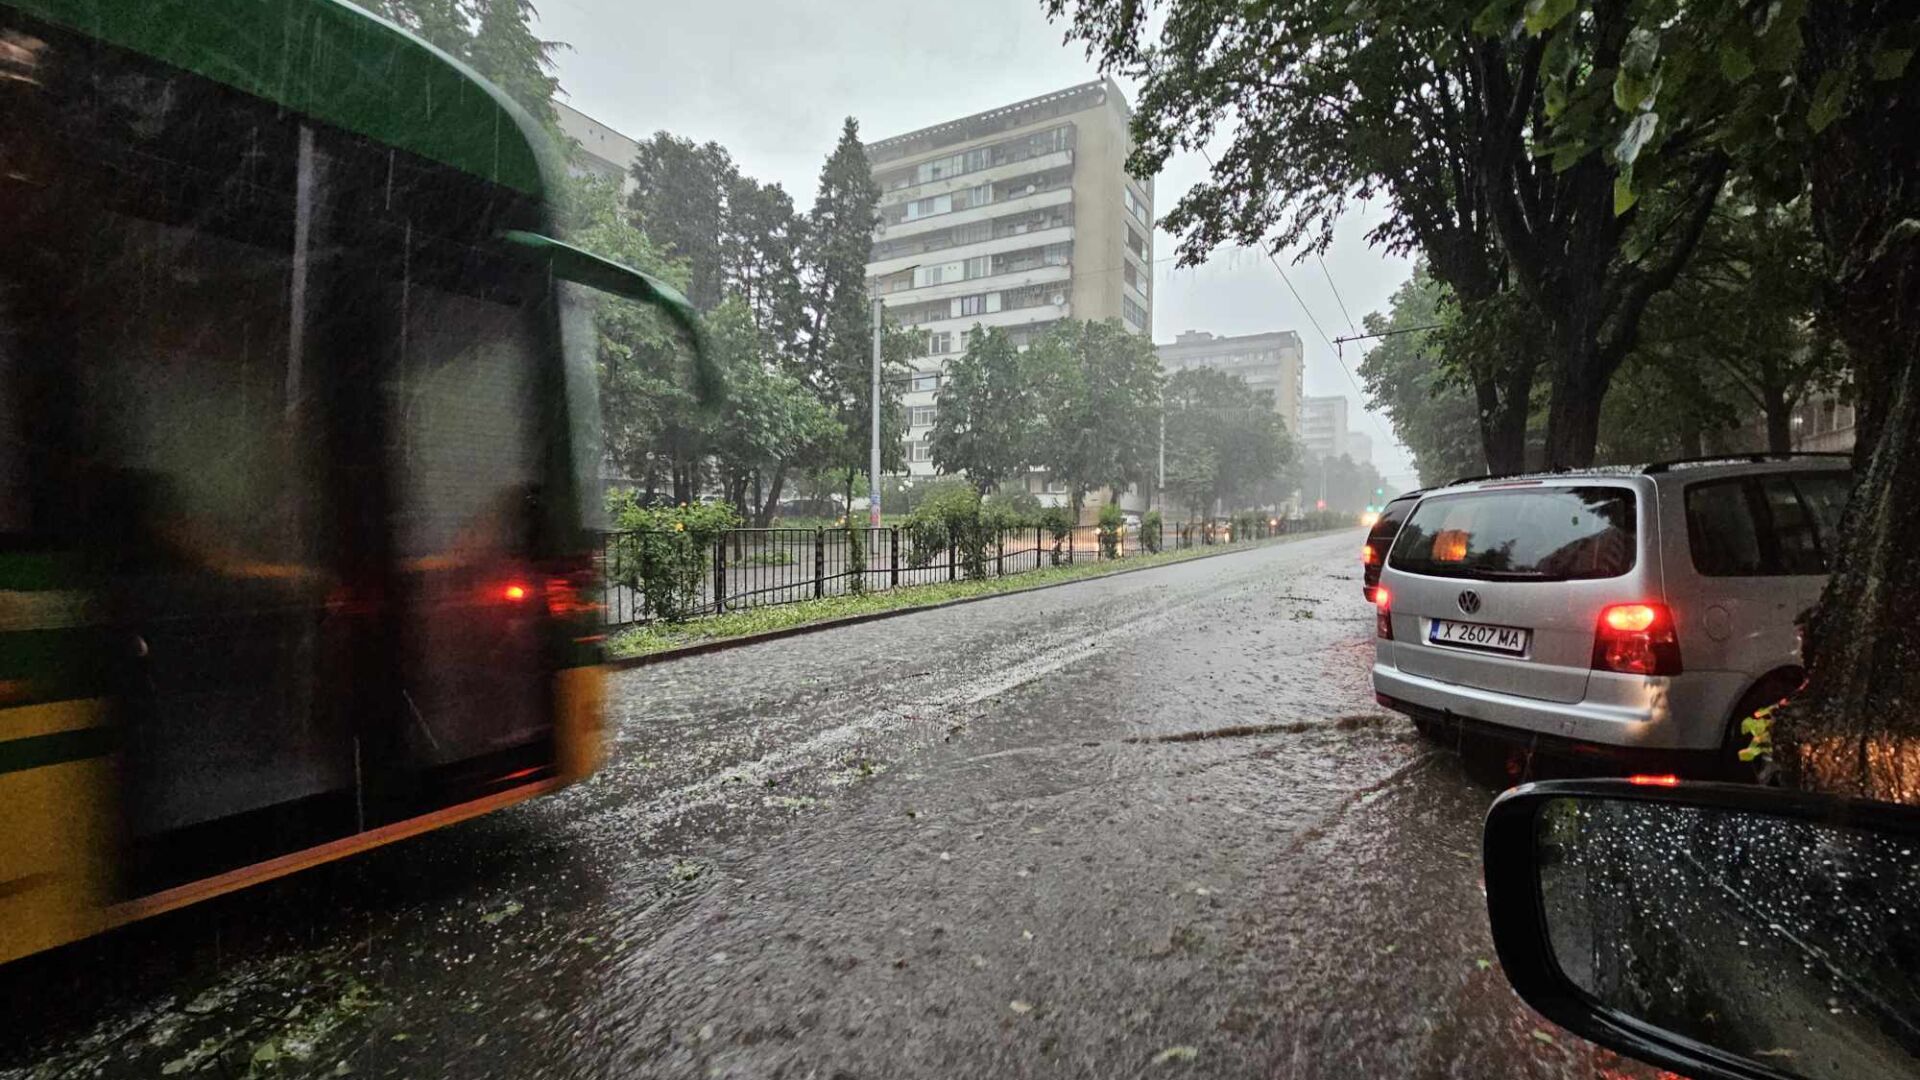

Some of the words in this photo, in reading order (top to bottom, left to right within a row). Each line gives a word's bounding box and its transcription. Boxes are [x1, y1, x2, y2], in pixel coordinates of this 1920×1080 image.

[1444, 623, 1454, 638] X
[1459, 625, 1496, 644] 2607
[1497, 628, 1519, 647] MA
